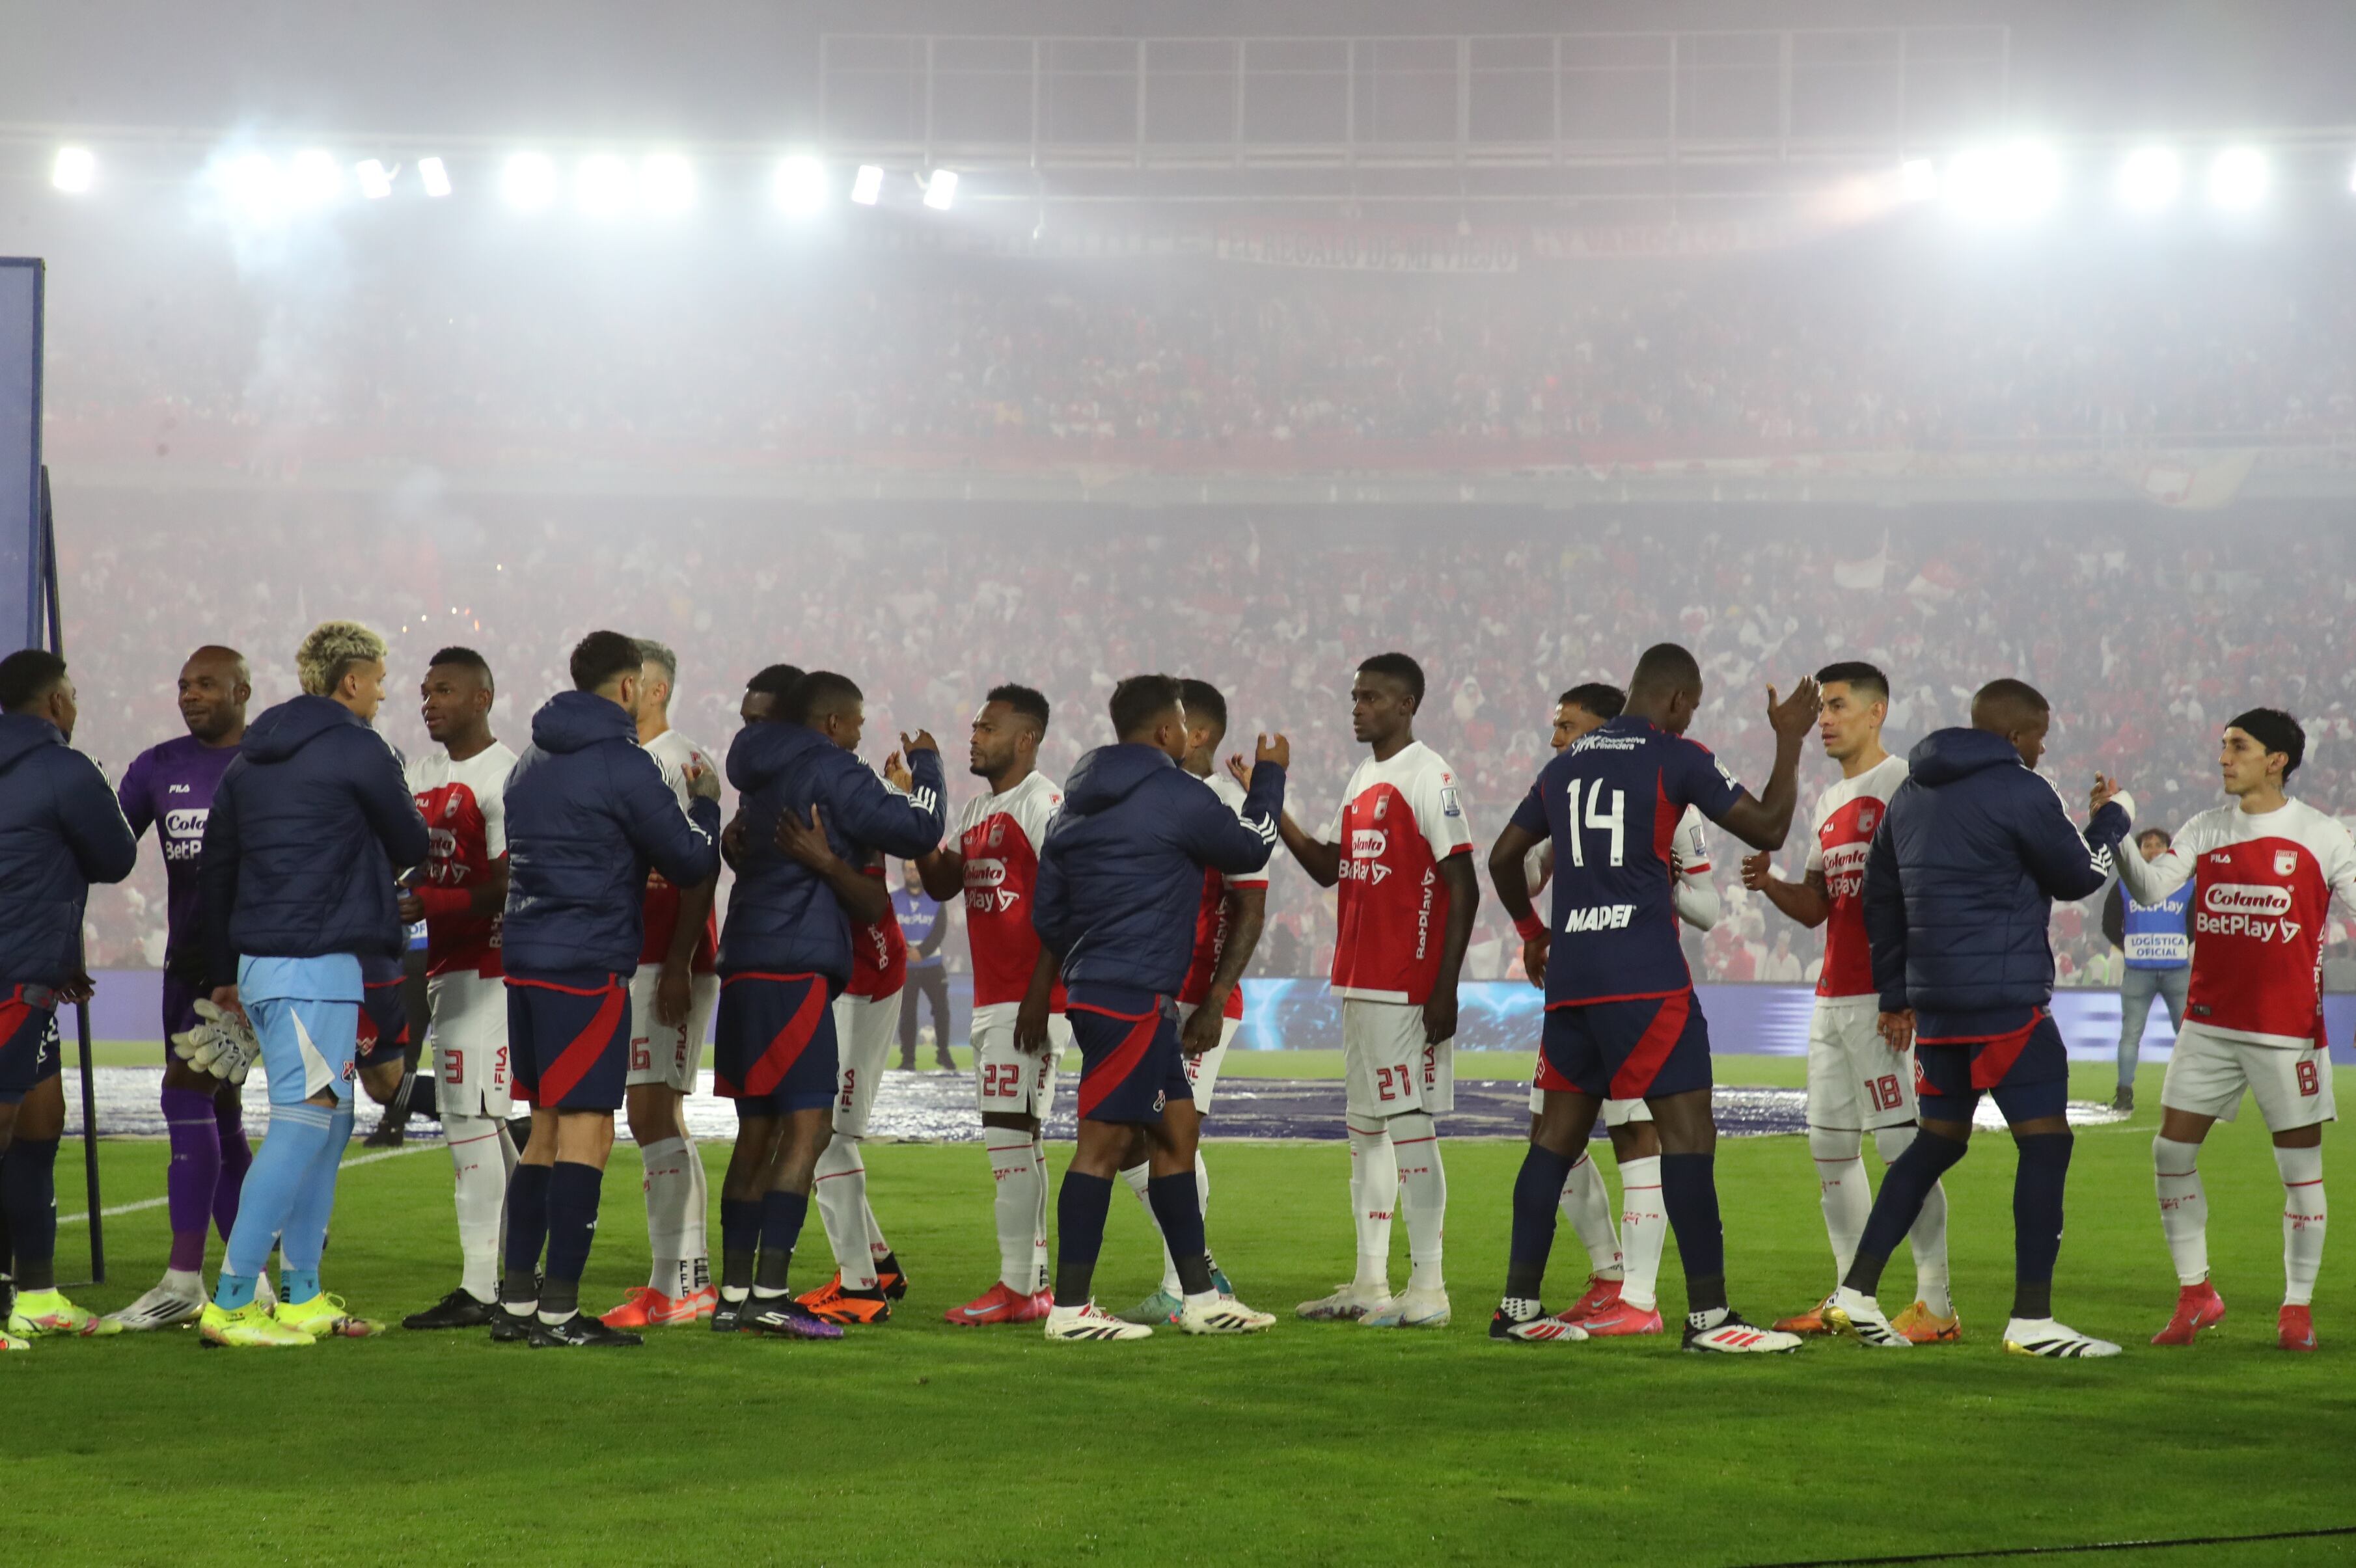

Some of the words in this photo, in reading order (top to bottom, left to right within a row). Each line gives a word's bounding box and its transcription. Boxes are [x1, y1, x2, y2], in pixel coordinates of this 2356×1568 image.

[169, 784, 190, 793] FILA
[168, 815, 206, 831] Cola
[1567, 777, 1624, 867] 14
[166, 840, 202, 860] BetP
[1352, 837, 1384, 851] olanta
[2210, 854, 2231, 863] FILA
[1339, 859, 1369, 883] BePlay
[2208, 889, 2288, 909] Colanta
[1565, 904, 1633, 932] MAPEI
[2197, 912, 2277, 943] BetPlay
[2137, 947, 2177, 956] OFICIAL
[445, 1049, 463, 1084] 3
[495, 1046, 507, 1084] FILA
[627, 1036, 650, 1072] 6
[1188, 1053, 1203, 1079] FIL
[1424, 1046, 1434, 1084] FILA
[842, 1068, 855, 1107] FILA
[983, 1064, 1019, 1096] 22
[1865, 1074, 1903, 1112] 18
[2298, 1061, 2319, 1096] 8
